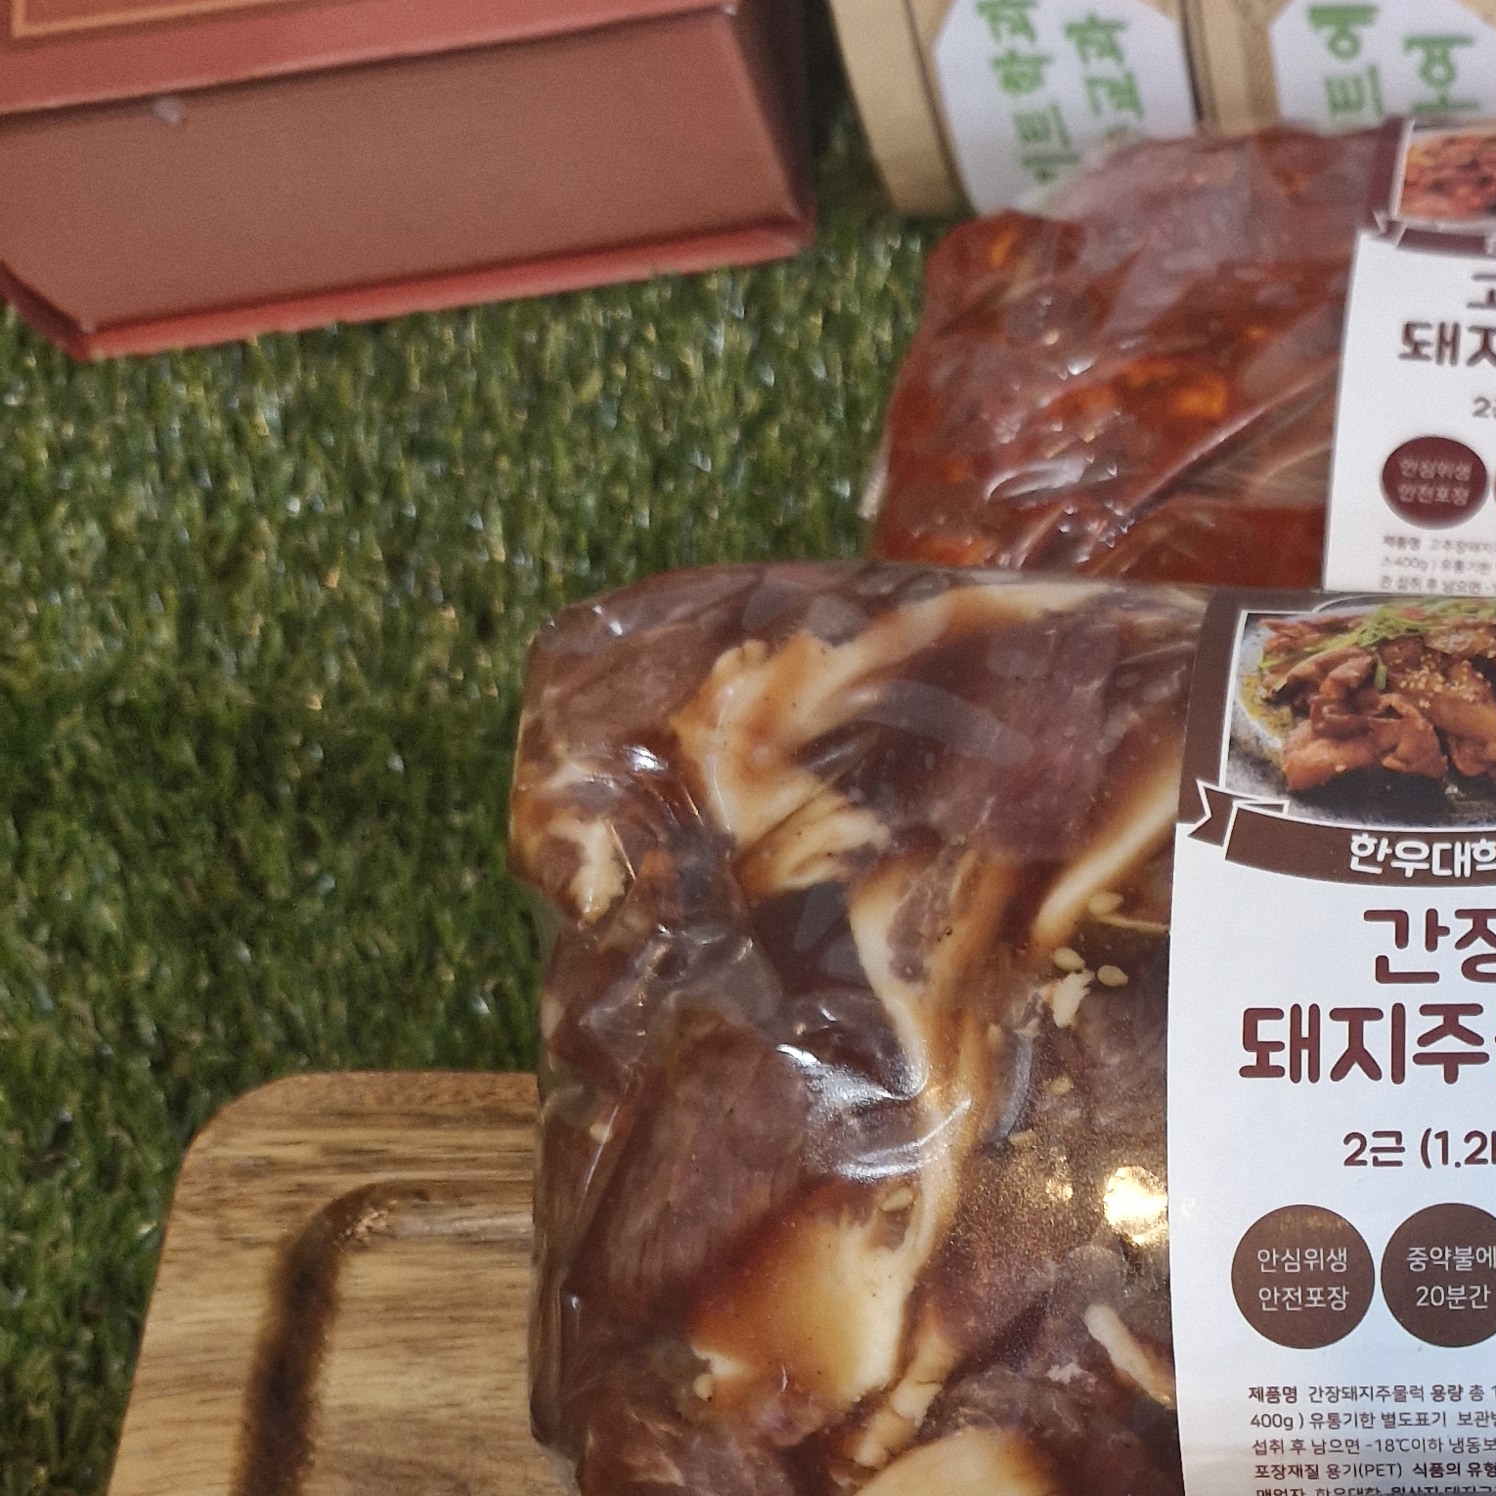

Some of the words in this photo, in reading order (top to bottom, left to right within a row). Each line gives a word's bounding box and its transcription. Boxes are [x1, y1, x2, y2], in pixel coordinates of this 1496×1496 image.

[1343, 1130, 1406, 1168] 2근
[1257, 1246, 1348, 1273] 안심위생
[1257, 1286, 1350, 1312] 안전포장
[1415, 1285, 1491, 1311] 20분간
[1249, 1386, 1298, 1404] 제품명
[1308, 1385, 1425, 1403] 간장돼지주물럭
[1430, 1384, 1464, 1402] 용량
[1469, 1384, 1485, 1402] 총
[1250, 1413, 1294, 1431] 400g
[1309, 1412, 1375, 1430] 유통기한
[1381, 1411, 1447, 1429] 별도표기
[1252, 1439, 1284, 1456] 섭취
[1289, 1438, 1306, 1456] 후
[1311, 1438, 1361, 1456] 남으면
[1254, 1463, 1320, 1480] 포장재질
[1325, 1462, 1402, 1480] 용기(PET)
[1412, 1462, 1461, 1478] 식품의
